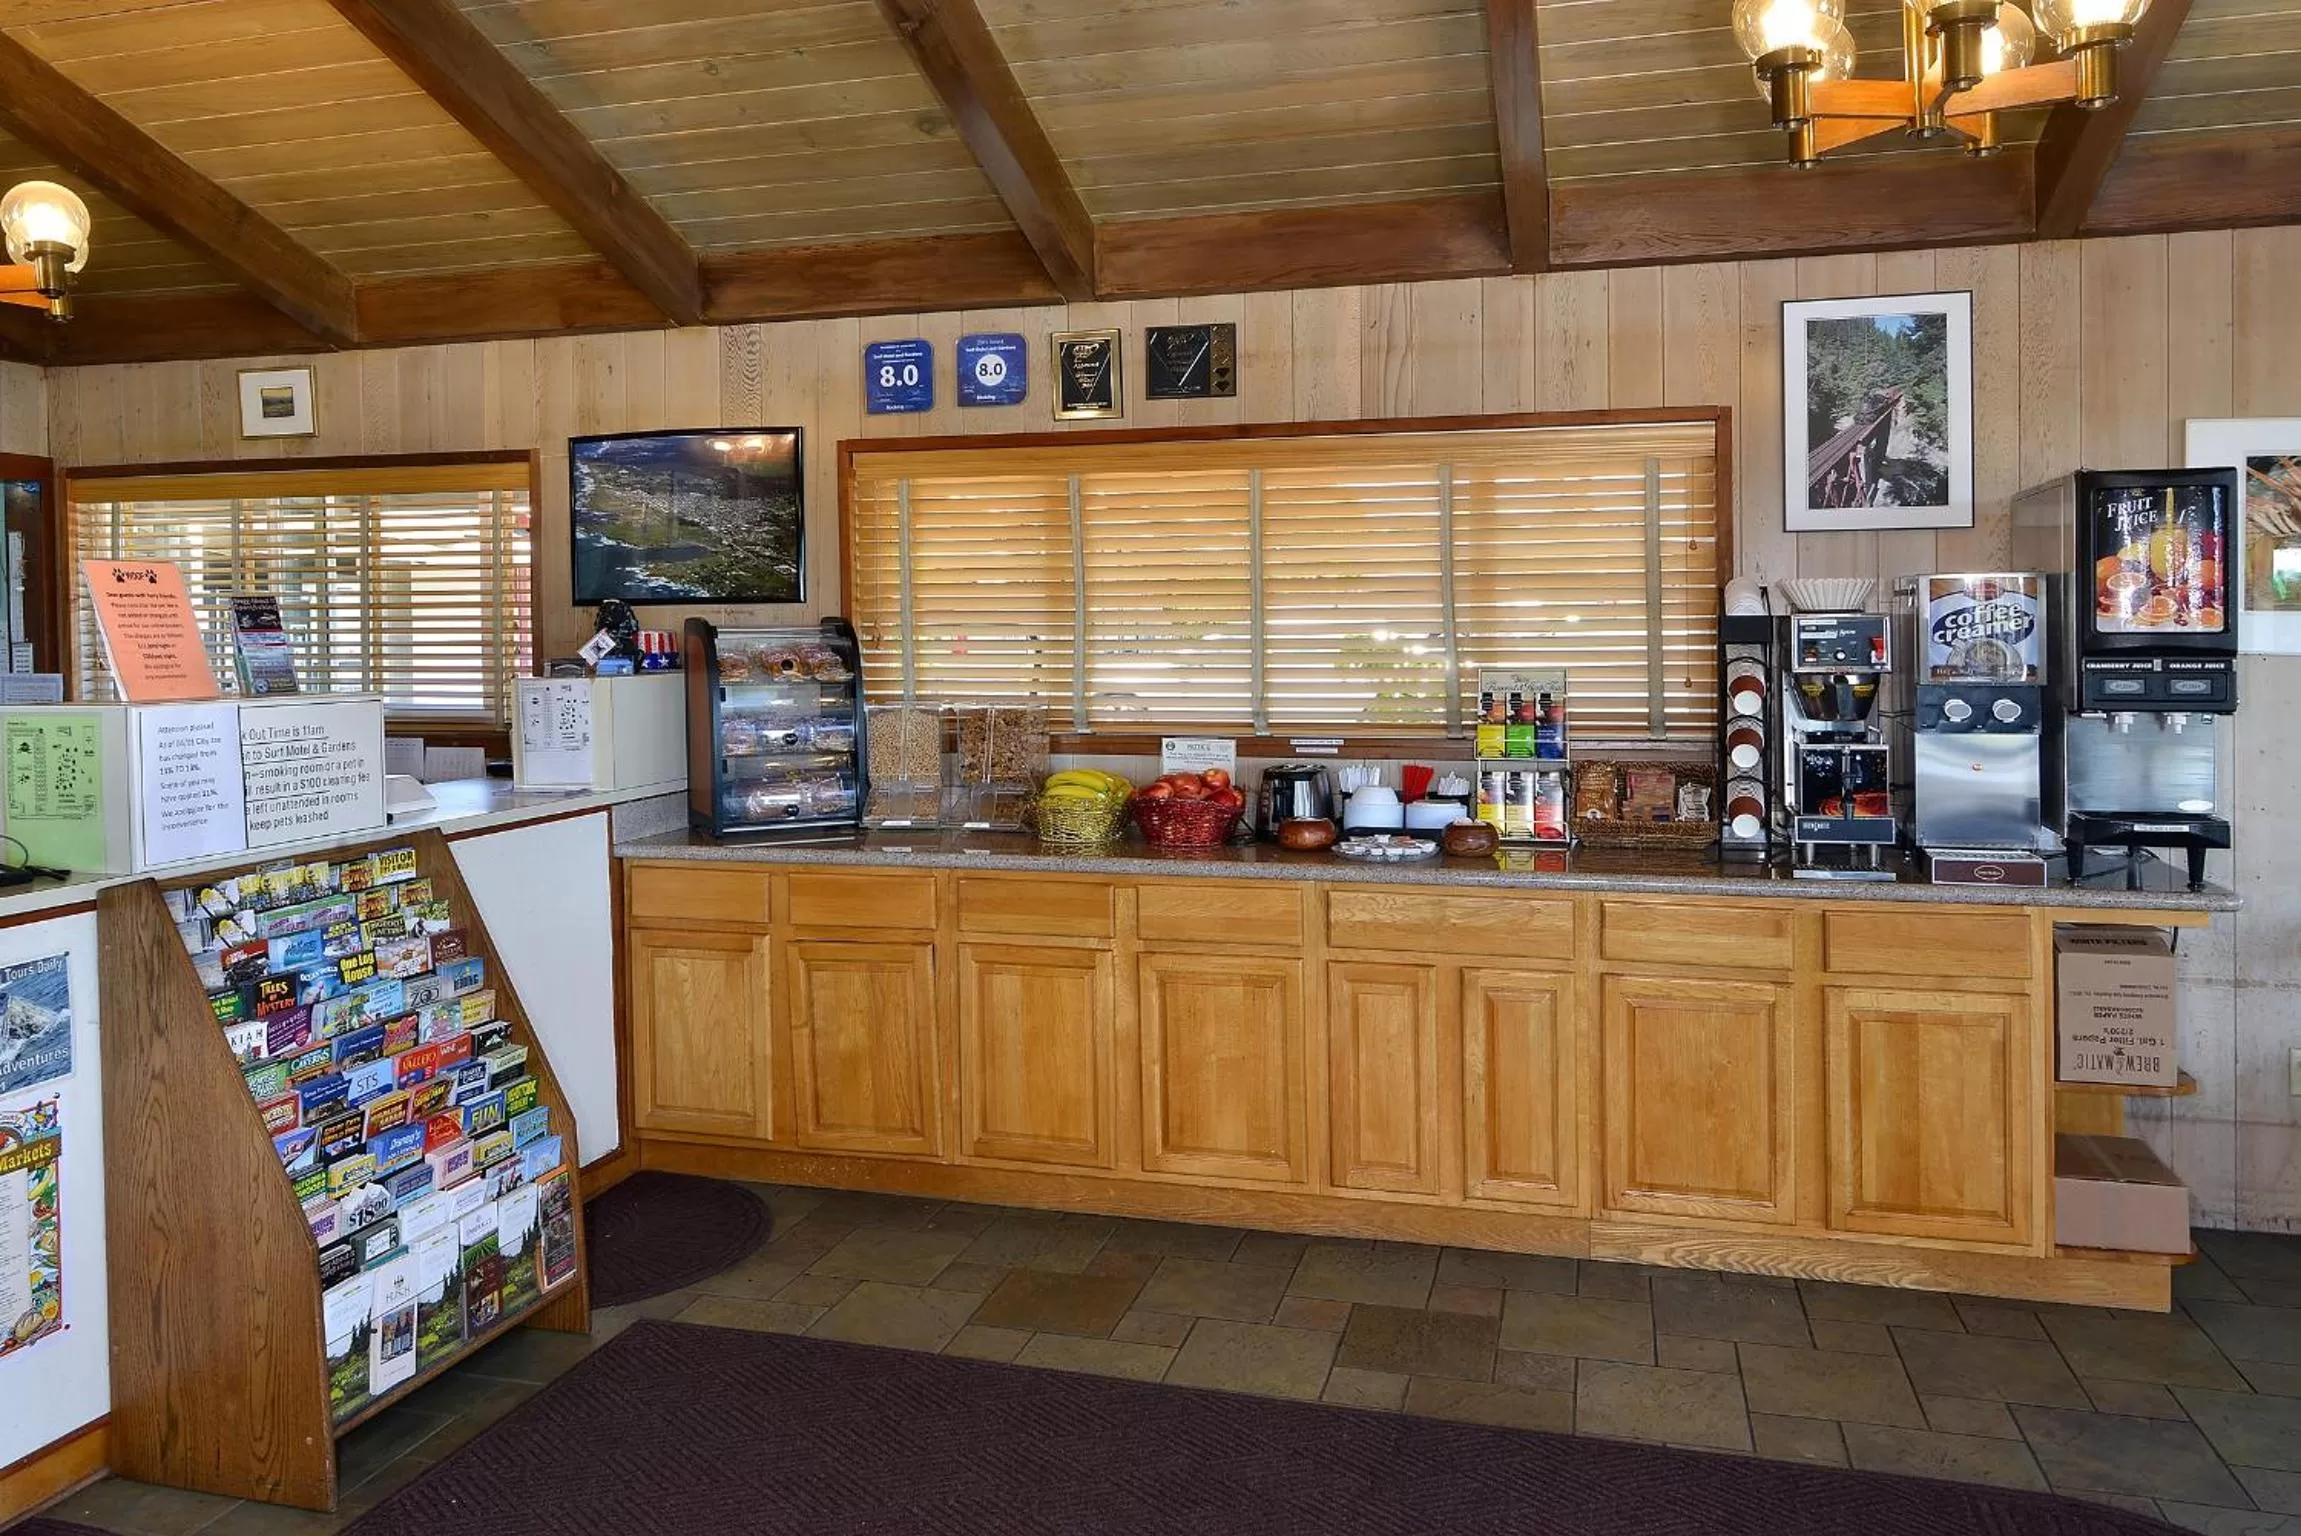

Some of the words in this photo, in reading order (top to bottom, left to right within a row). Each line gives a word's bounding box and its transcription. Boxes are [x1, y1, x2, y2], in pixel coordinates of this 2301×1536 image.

[879, 363, 919, 388] 8.0
[978, 362, 1003, 377] 8.0
[2107, 496, 2153, 518] FRUIT
[2114, 510, 2158, 532] JUICE
[1944, 602, 2021, 629] coffee
[1933, 613, 2036, 644] creamer
[248, 727, 267, 741] Out
[267, 726, 291, 739] Time
[292, 724, 300, 736] is
[302, 724, 325, 736] 11am
[252, 748, 263, 760] to
[263, 745, 285, 759] Surf
[286, 743, 311, 757] Motel
[312, 743, 320, 755] &
[321, 740, 357, 754] Gardens
[300, 763, 326, 775] room
[326, 761, 335, 772] or
[342, 759, 357, 771] pet
[255, 780, 282, 796] result
[282, 780, 291, 792] in
[292, 781, 299, 792] a
[300, 776, 322, 791] $100
[322, 773, 357, 788] cleaning
[358, 771, 371, 784] fee
[252, 801, 269, 816] left
[269, 795, 320, 813] unattended
[321, 793, 330, 806] in
[330, 790, 359, 805] rooms
[249, 818, 272, 832] keep
[273, 814, 293, 830] pets
[294, 809, 330, 825] leashed
[377, 850, 414, 867] VISITOR
[5, 966, 34, 982] Tours
[37, 958, 63, 974] Daily
[340, 958, 358, 972] One
[358, 951, 375, 965] Log
[343, 964, 375, 984] House
[256, 996, 297, 1019] MYSTERY
[230, 1028, 264, 1047] KIAH
[2072, 1034, 2107, 1044] Papers
[2108, 1036, 2135, 1046] Filter
[2138, 1037, 2157, 1046] Gal.
[2125, 1054, 2161, 1073] BREW
[472, 1101, 499, 1124] FUN
